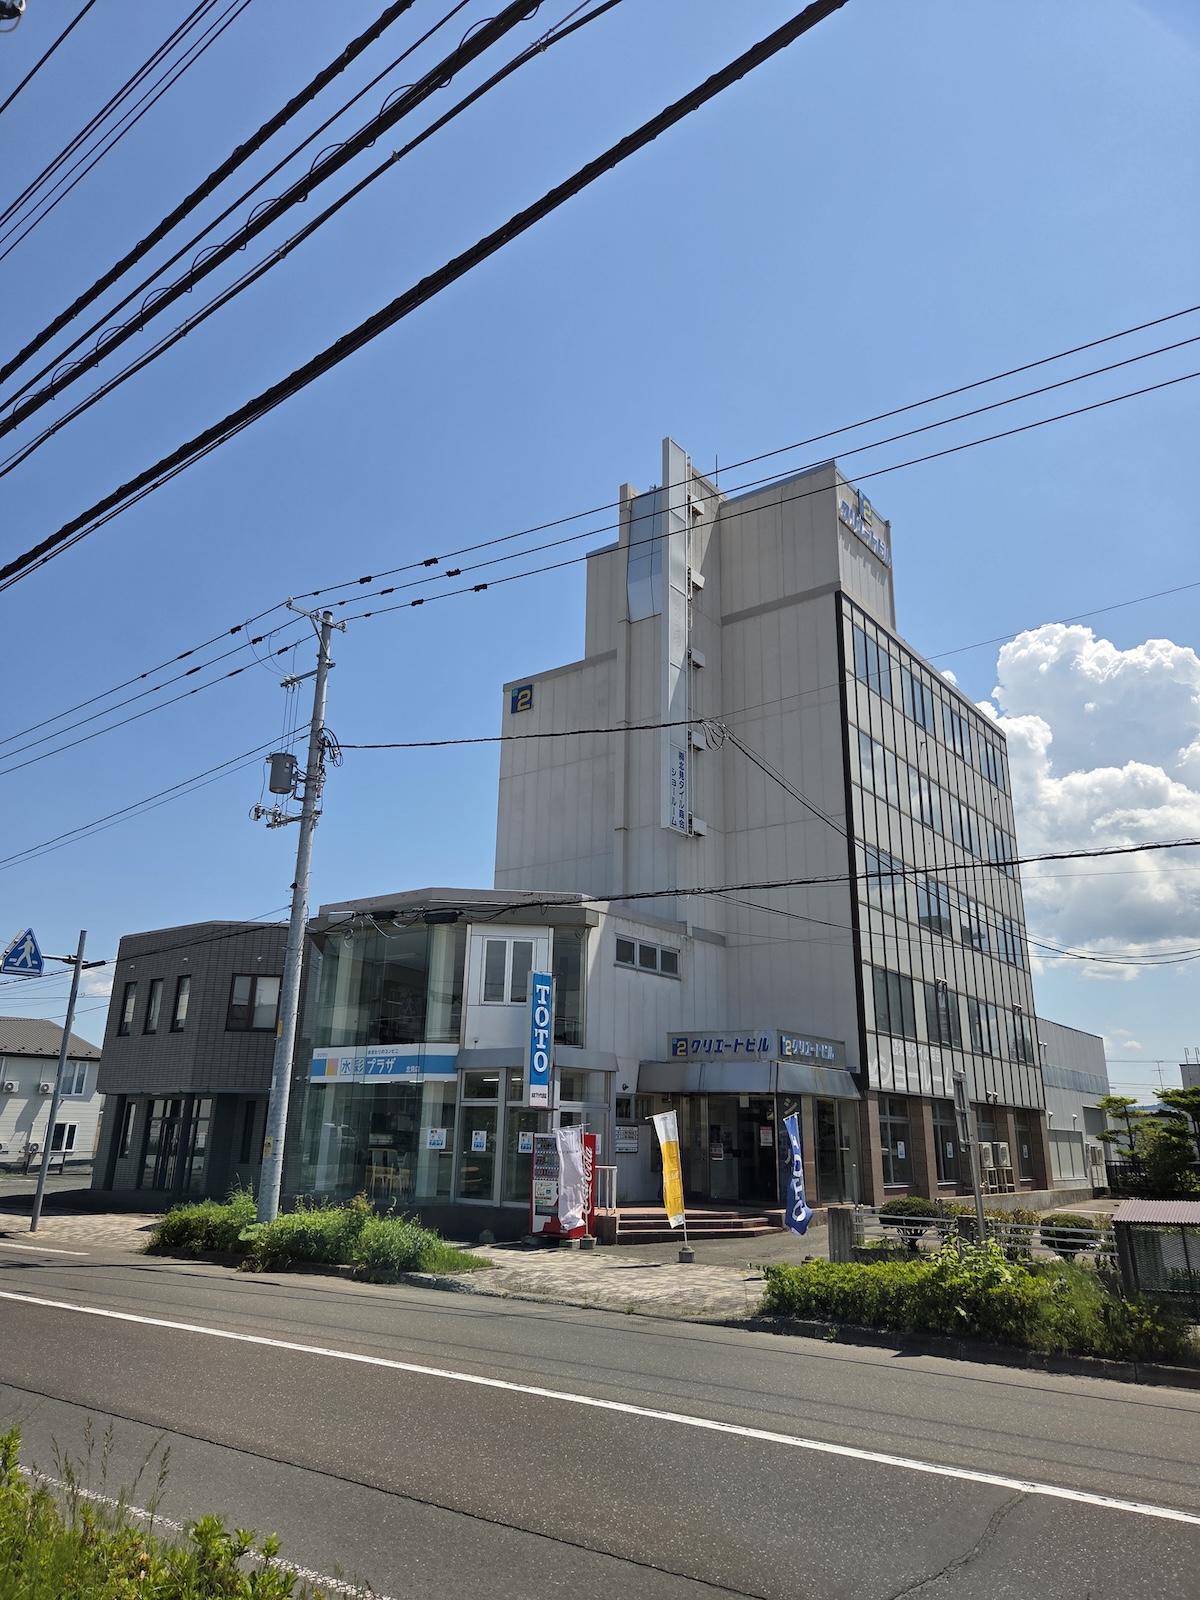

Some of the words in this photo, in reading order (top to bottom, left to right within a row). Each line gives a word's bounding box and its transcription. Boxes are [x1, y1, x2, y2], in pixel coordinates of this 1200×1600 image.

[534, 984, 550, 1073] TOTO
[691, 1037, 770, 1054] クリエートビル
[792, 1039, 835, 1061] クリエートビル
